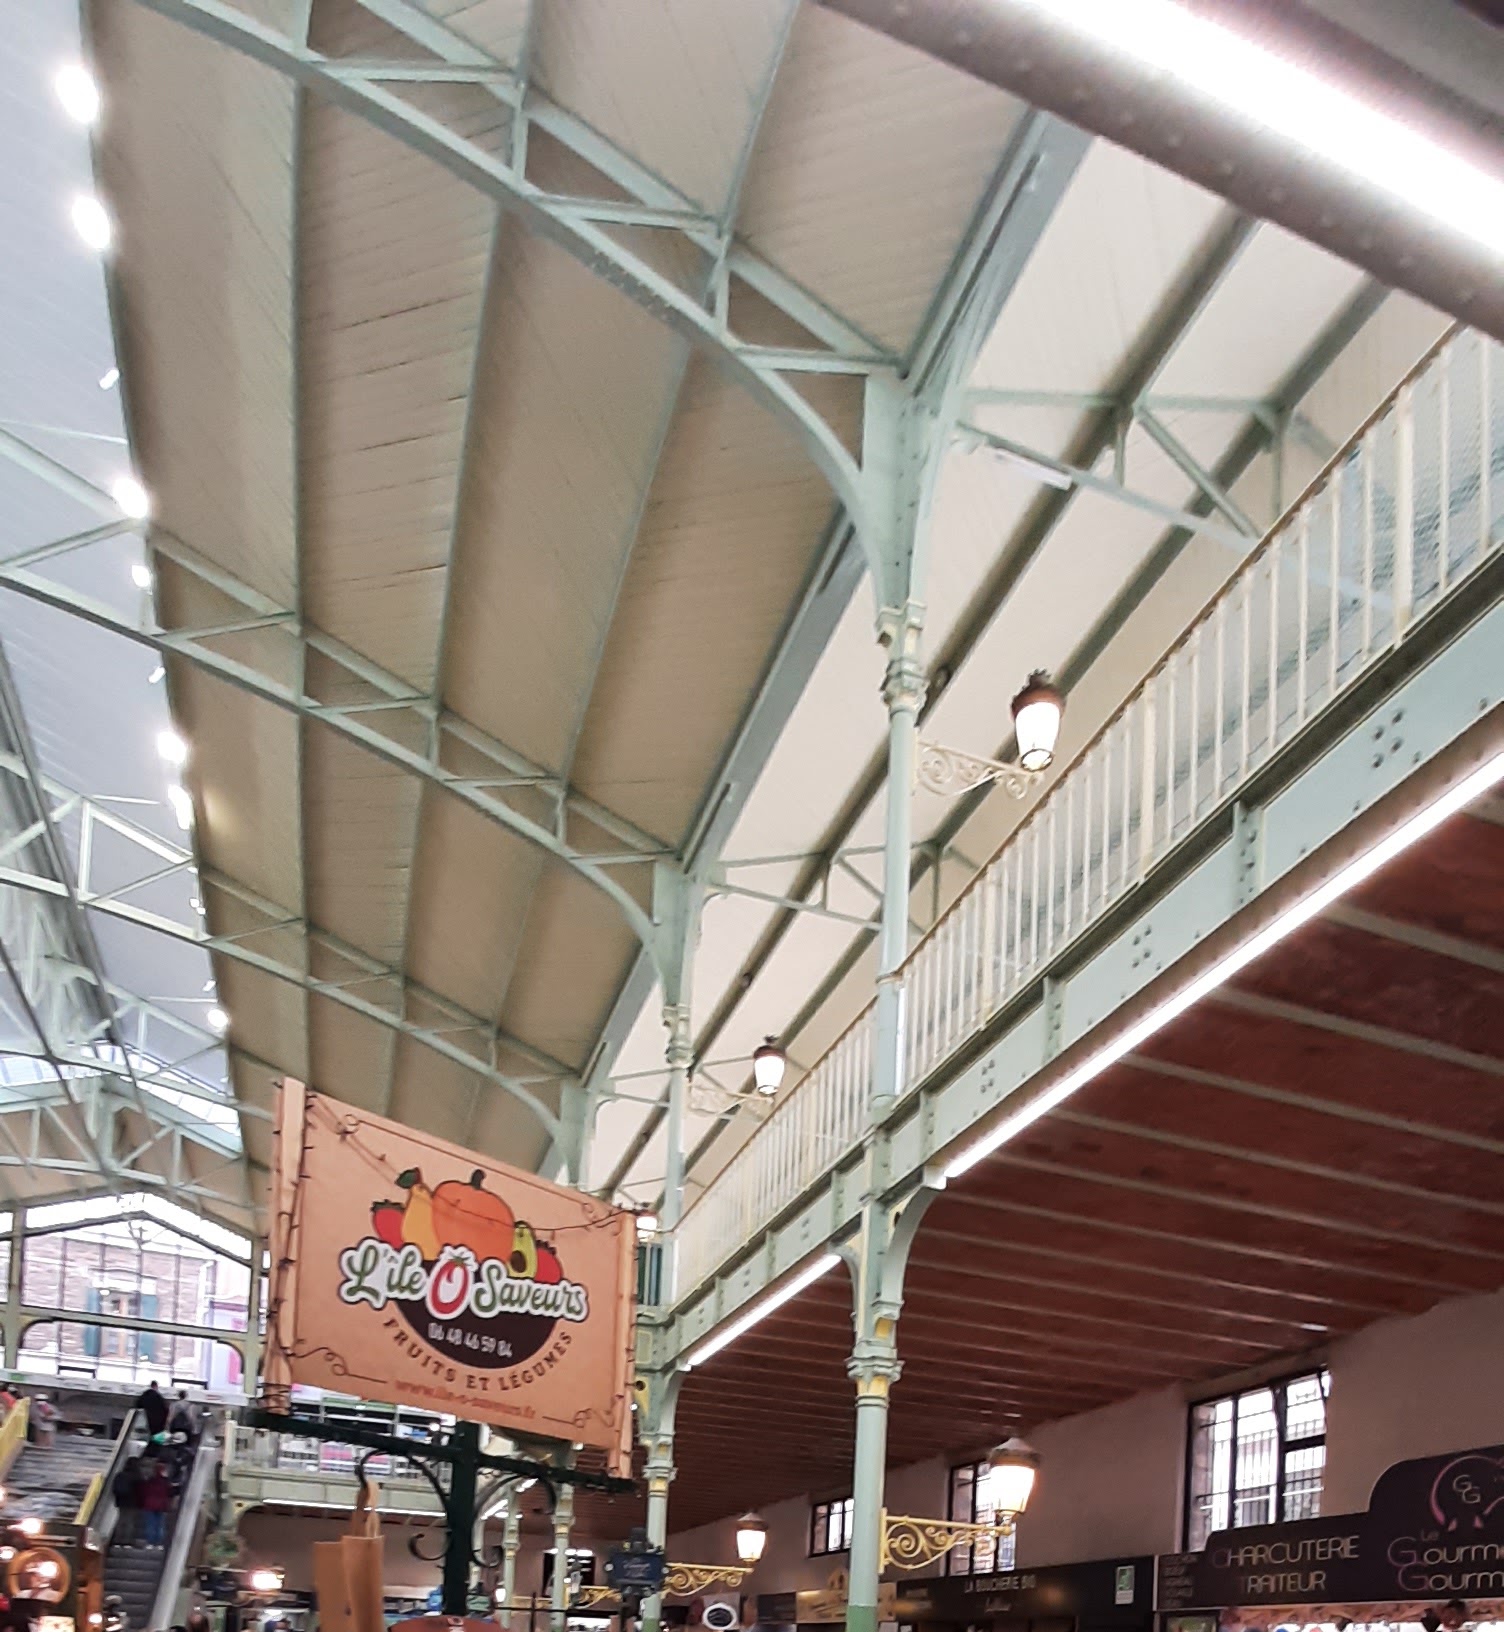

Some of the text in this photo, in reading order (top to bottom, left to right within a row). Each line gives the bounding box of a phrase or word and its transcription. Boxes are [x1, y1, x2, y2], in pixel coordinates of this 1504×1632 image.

[431, 1255, 469, 1315] O
[474, 1263, 585, 1316] Saveurs
[383, 1318, 572, 1391] FRUITS ET LÉGUMES
[1211, 1535, 1361, 1569] CHARCUTERIE
[1241, 1570, 1327, 1594] TRAITEUR
